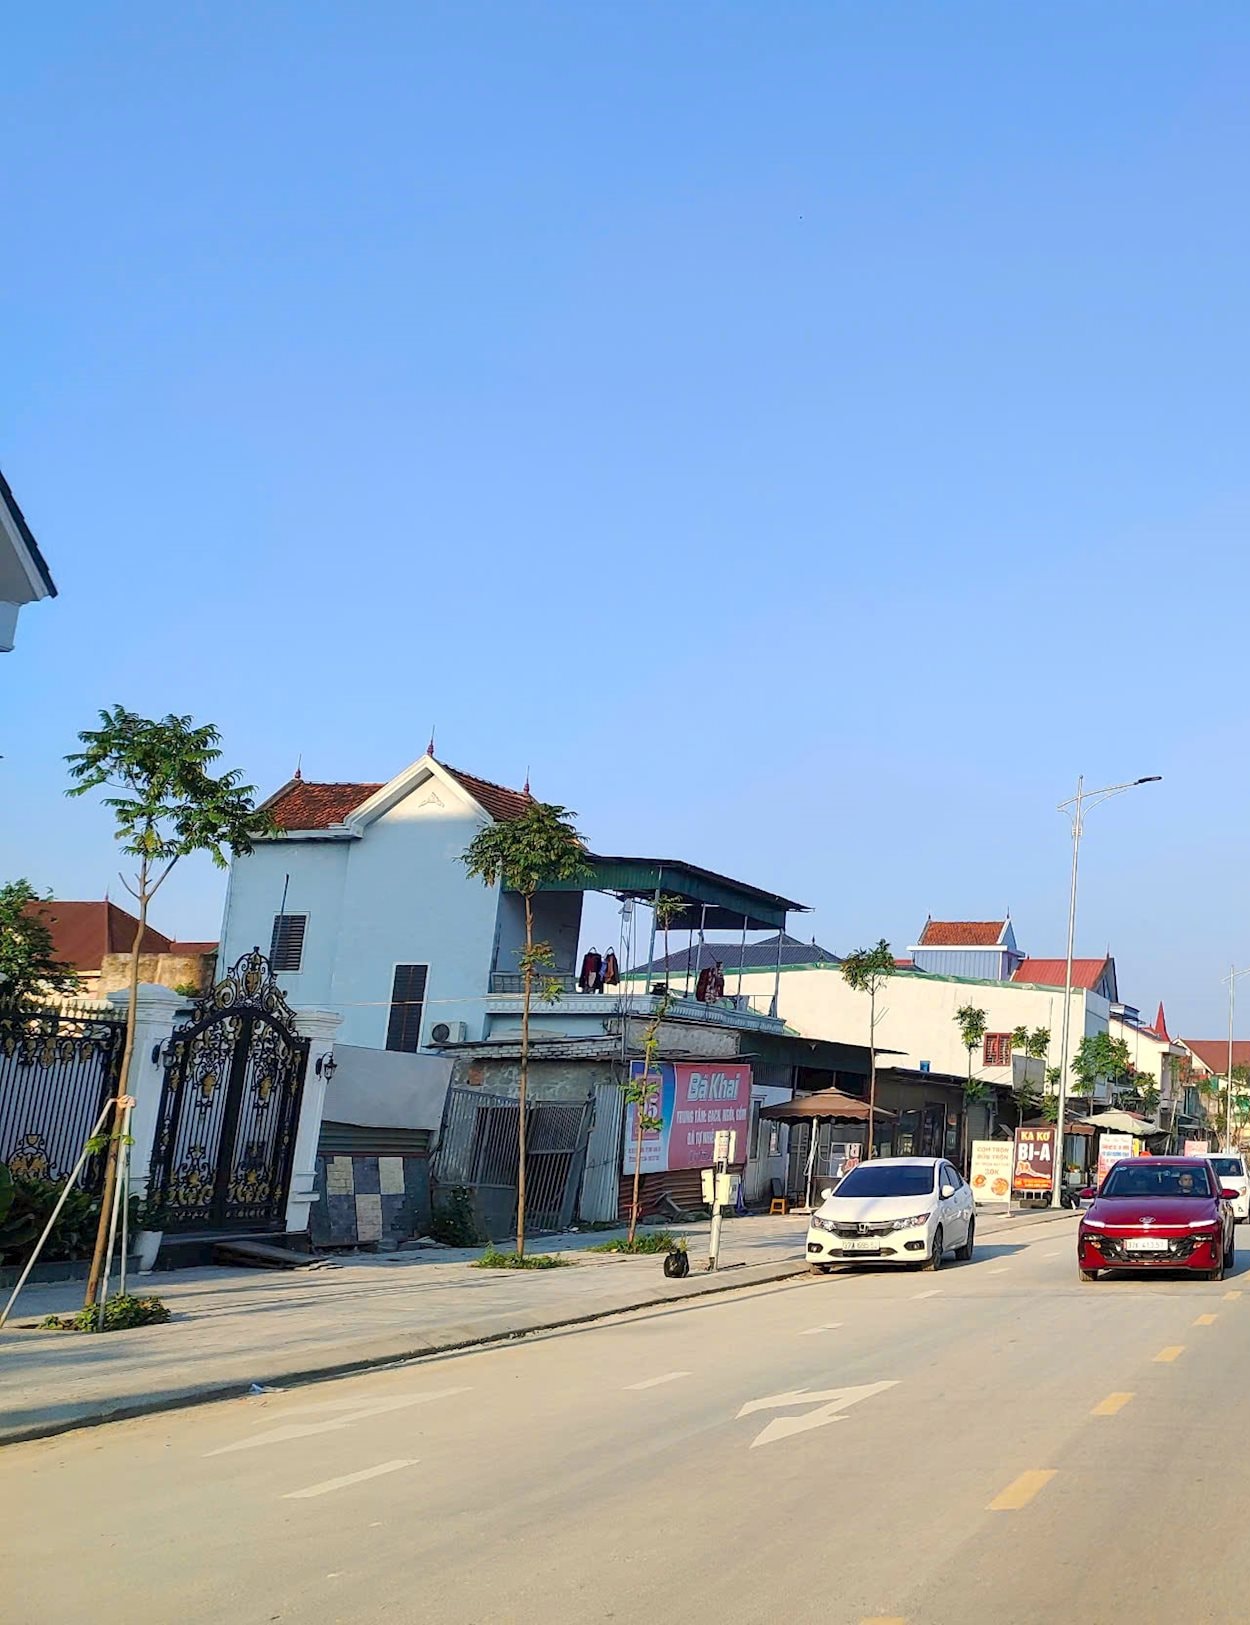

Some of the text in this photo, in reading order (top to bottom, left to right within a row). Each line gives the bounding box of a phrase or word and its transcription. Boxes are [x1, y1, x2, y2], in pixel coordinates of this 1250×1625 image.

[709, 1072, 740, 1101] Khai
[1021, 1131, 1034, 1140] KA
[1018, 1143, 1050, 1160] BI-A
